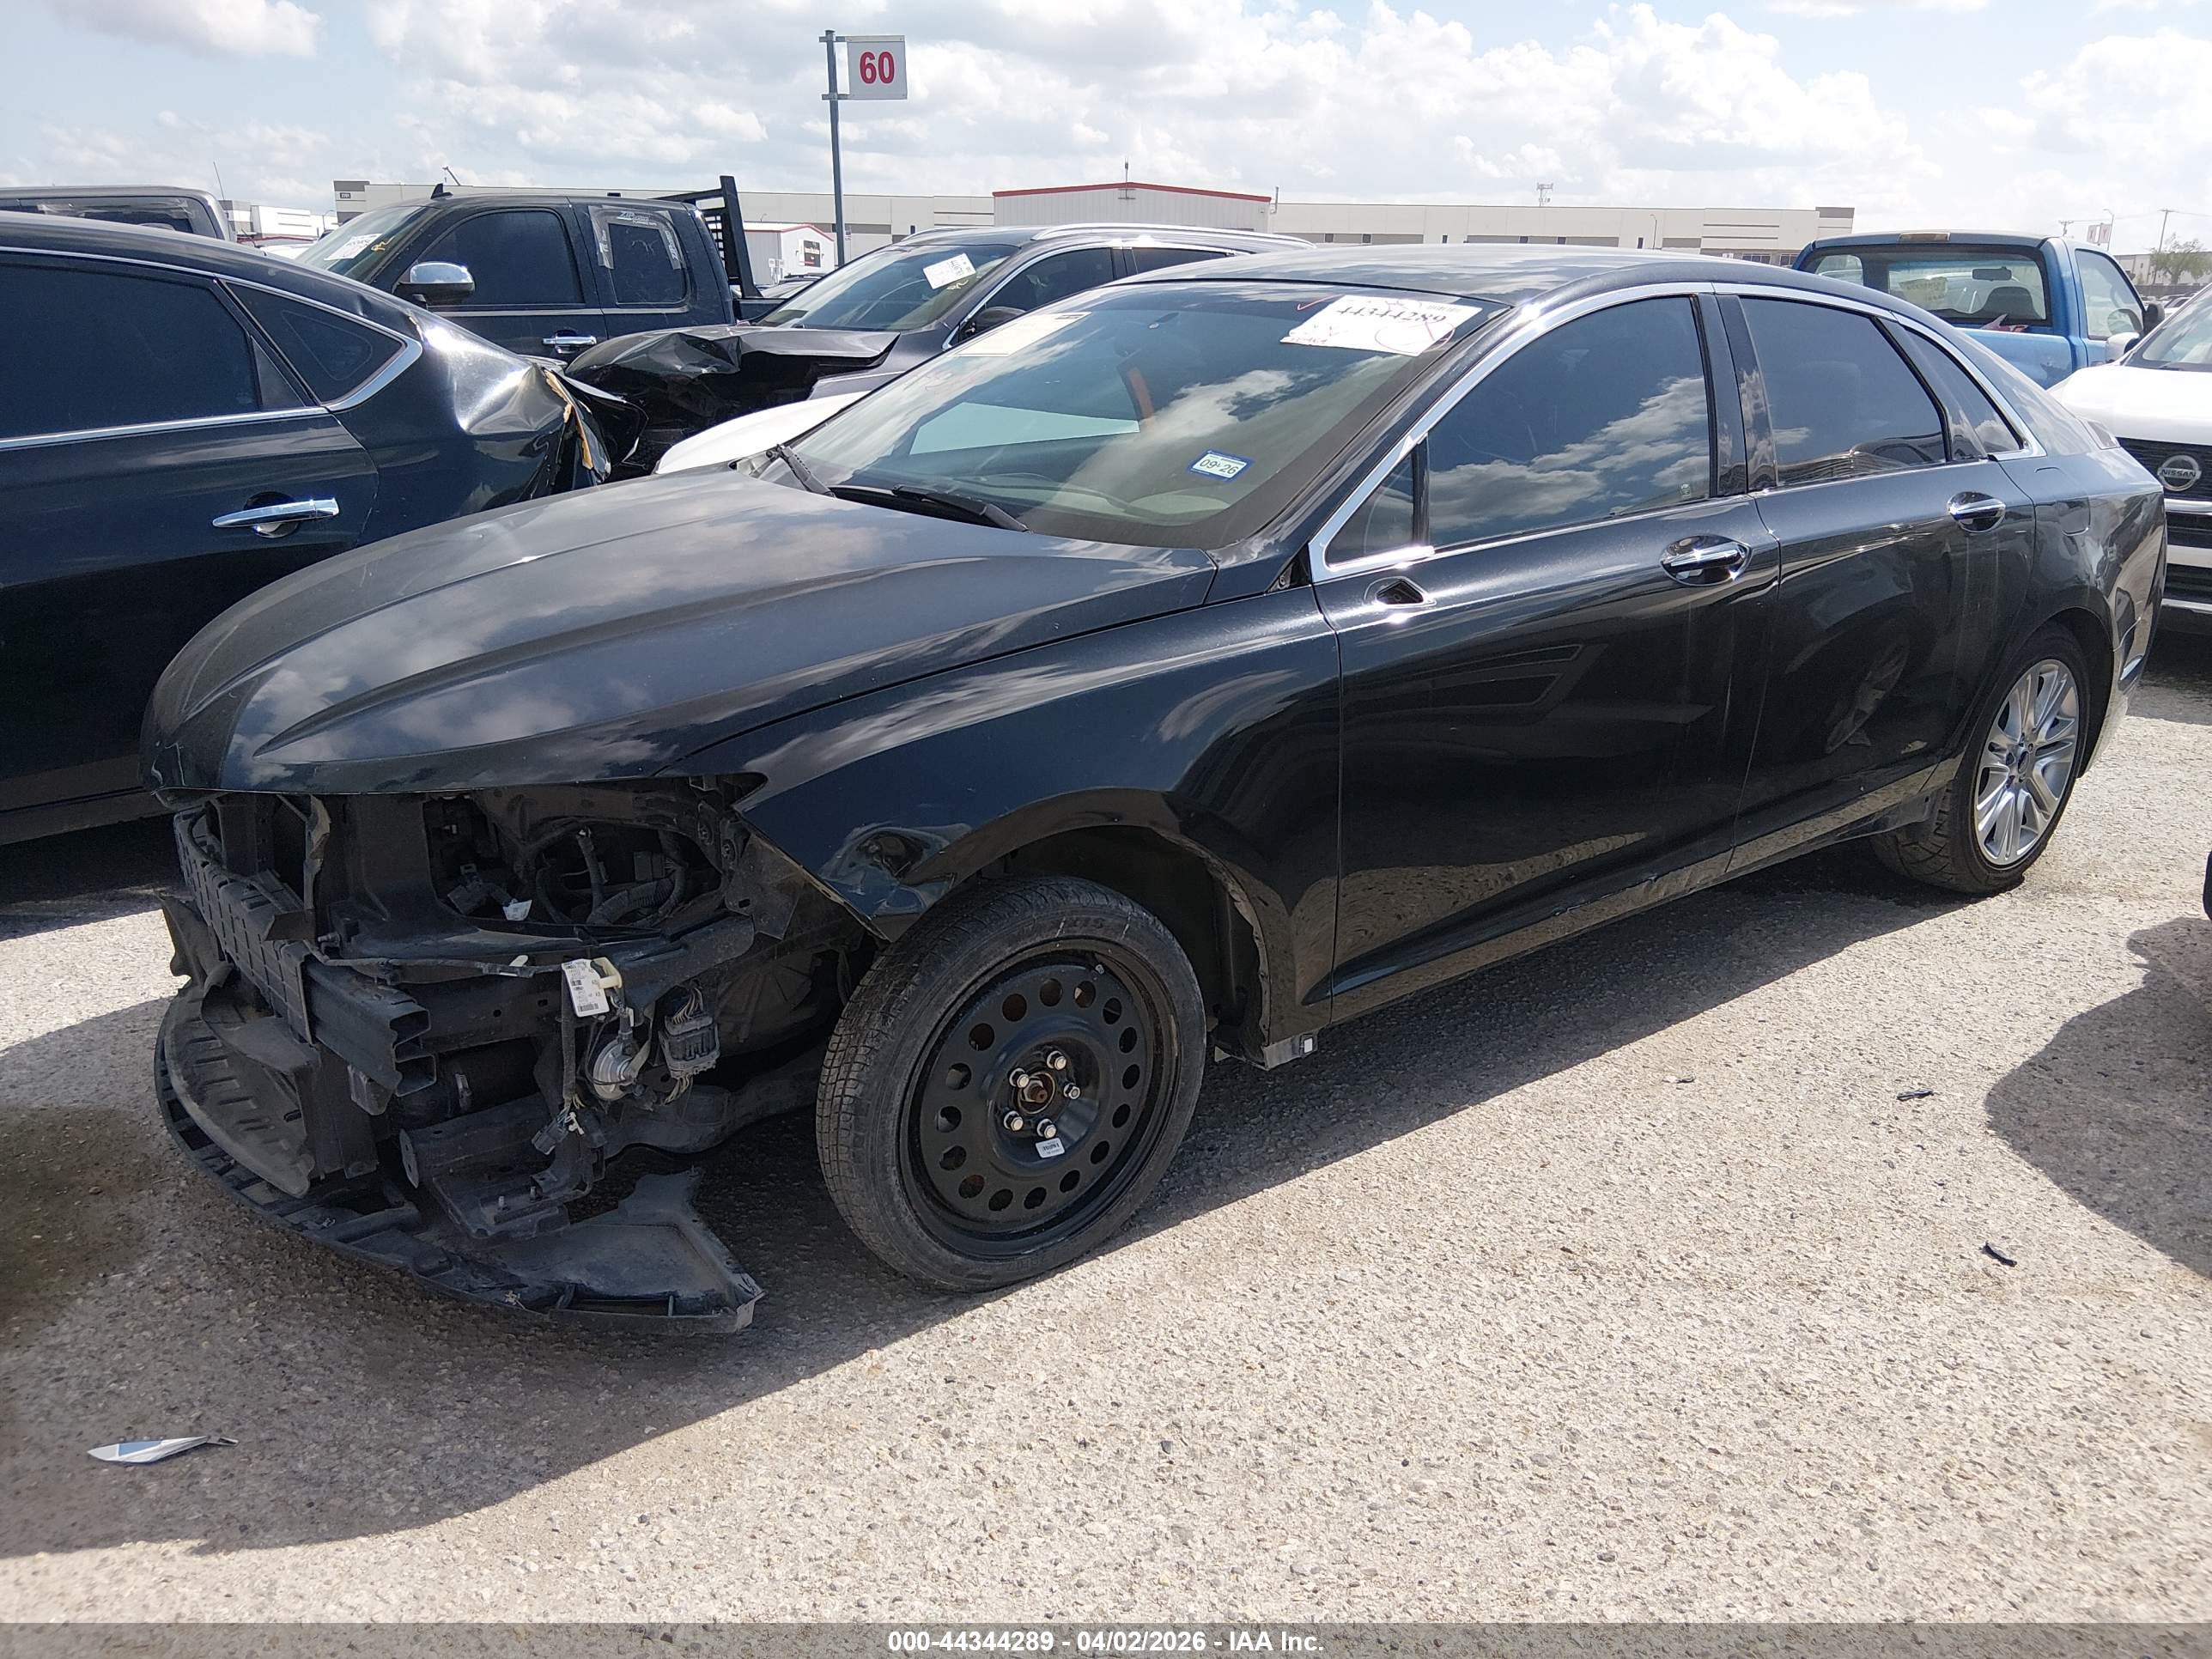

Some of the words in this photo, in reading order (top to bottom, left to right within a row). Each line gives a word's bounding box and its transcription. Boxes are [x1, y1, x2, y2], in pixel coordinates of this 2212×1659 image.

[860, 51, 895, 84] 60
[1336, 306, 1447, 323] 44344289
[1199, 459, 1217, 469] 09
[1218, 464, 1239, 475] 26
[2159, 469, 2197, 477] NISSAN
